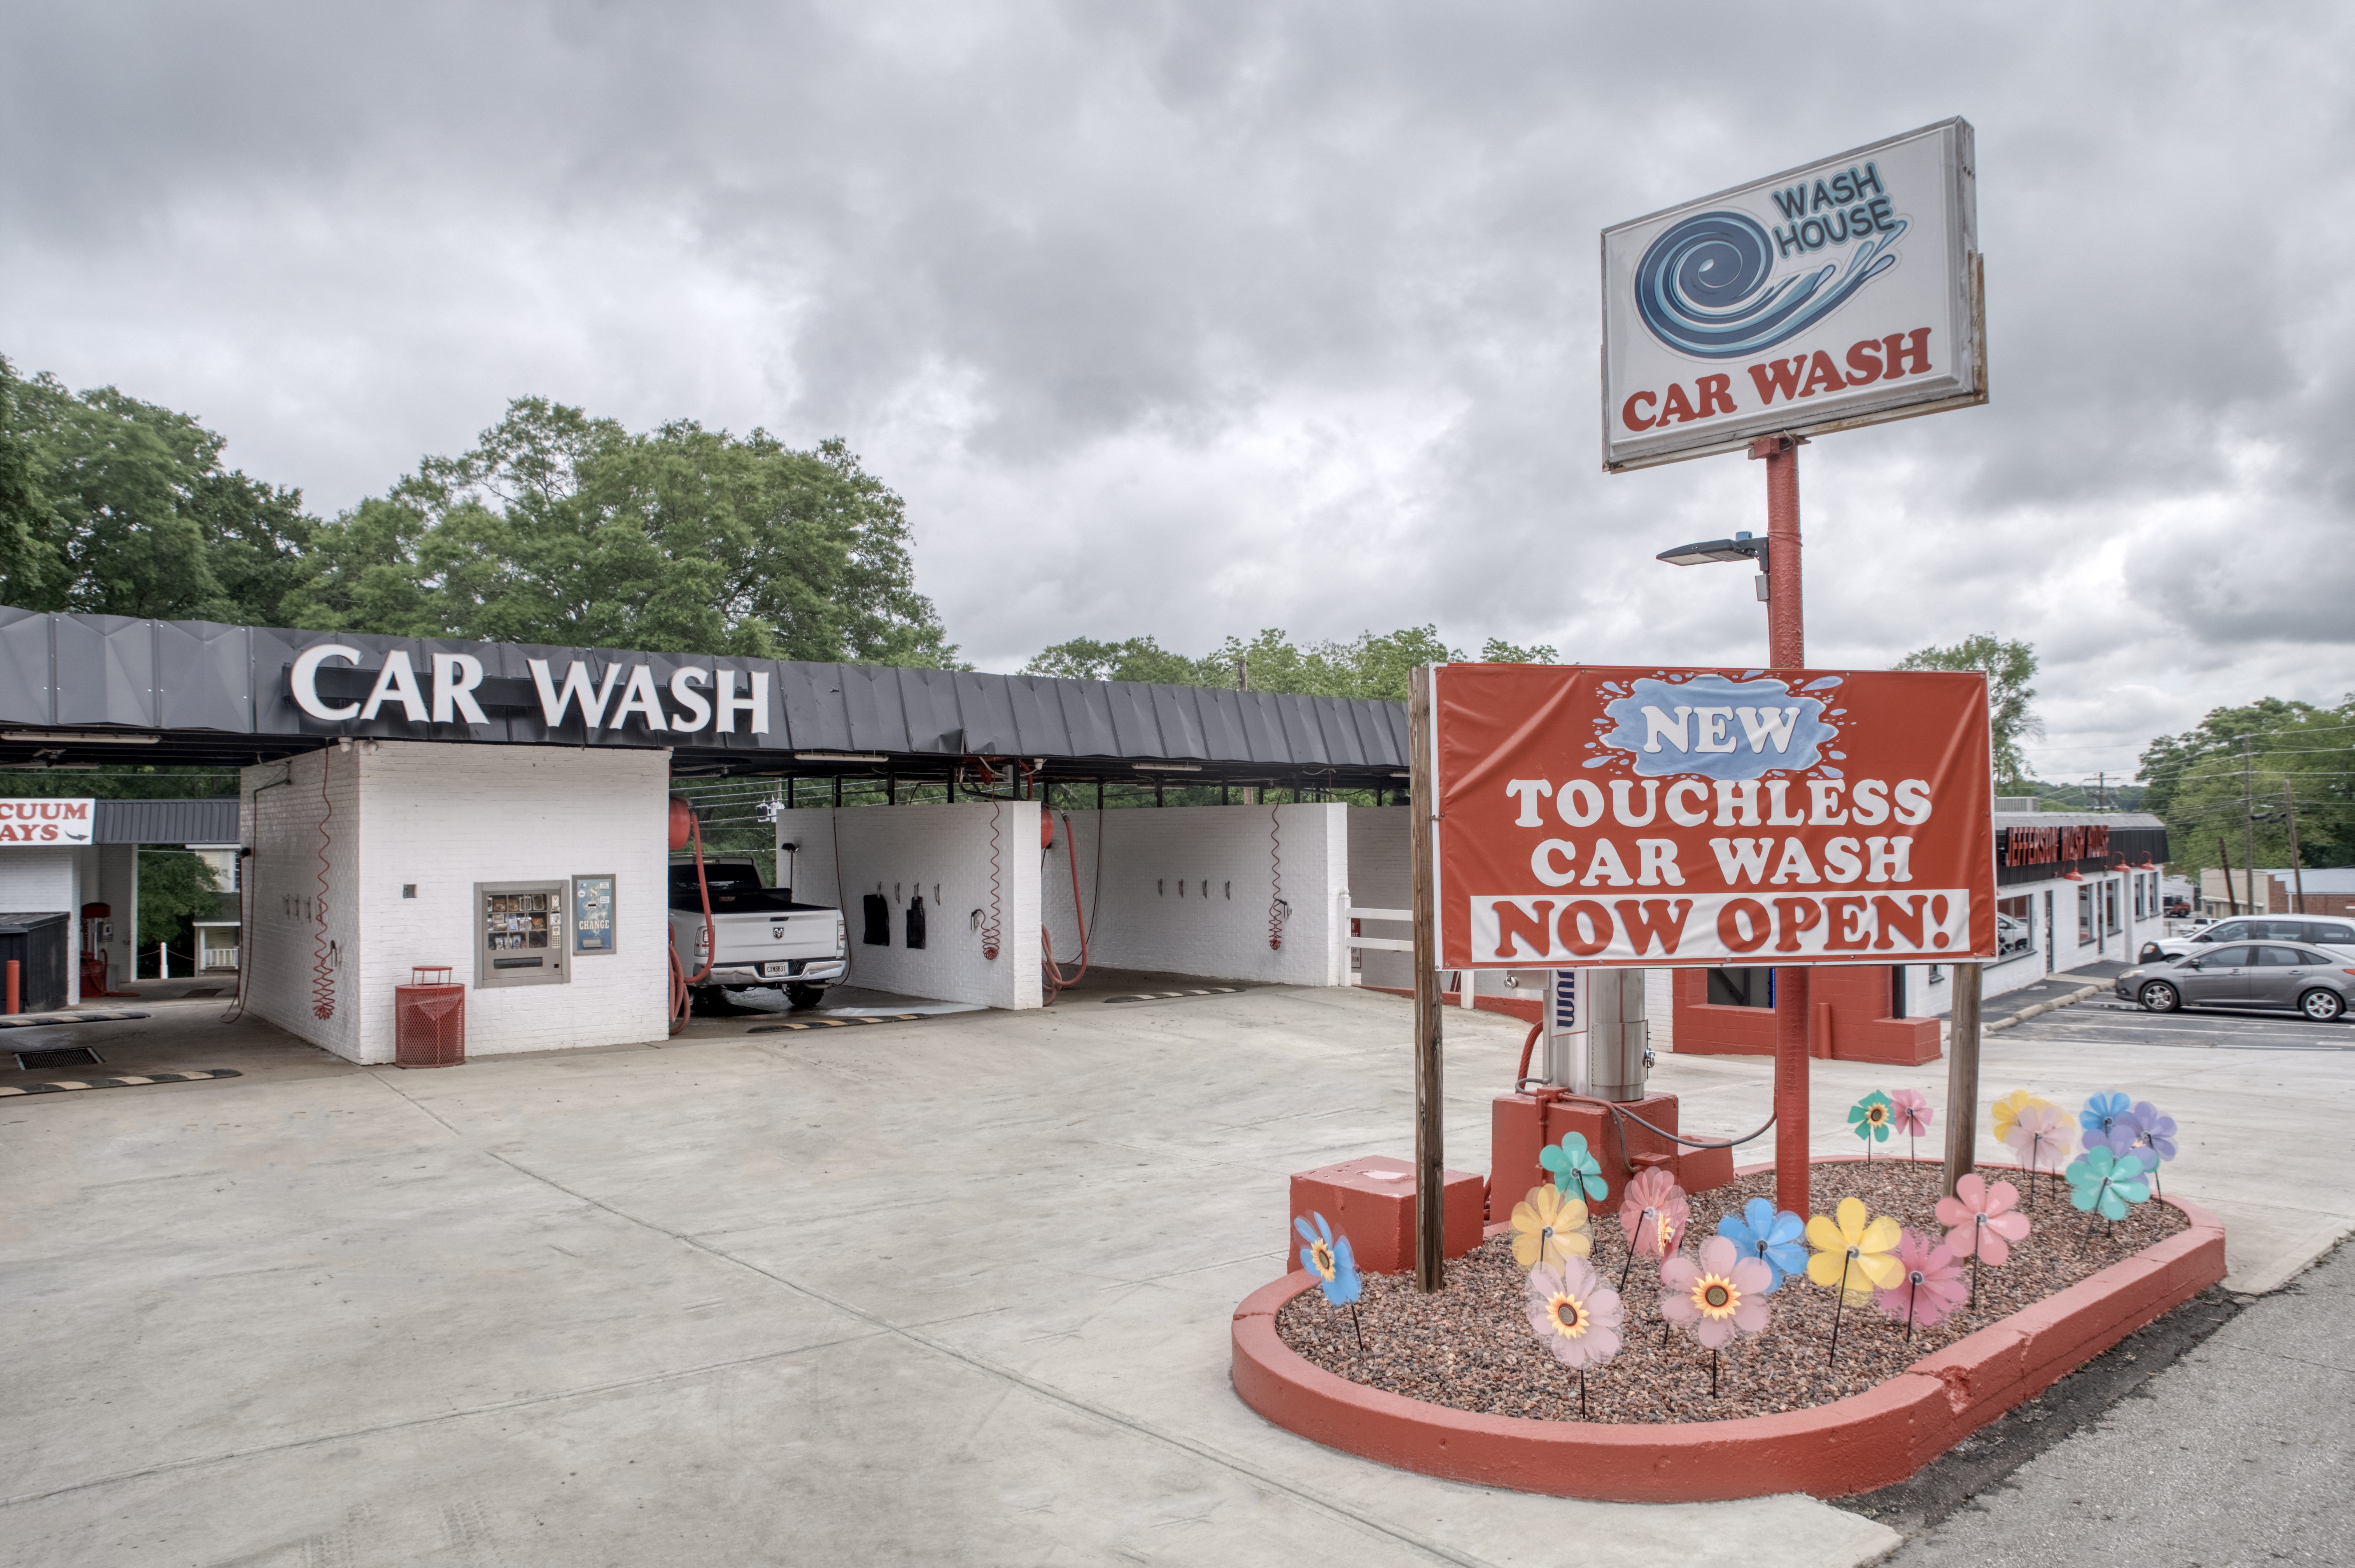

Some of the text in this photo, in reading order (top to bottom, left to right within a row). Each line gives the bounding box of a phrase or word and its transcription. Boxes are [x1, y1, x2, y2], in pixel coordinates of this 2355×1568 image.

[1774, 165, 1881, 219] WASH
[1774, 198, 1896, 256] HOUSE
[1622, 327, 1932, 432] CAR WASH
[291, 644, 769, 734] CAR WASH
[1641, 705, 1801, 753] NEW
[0, 803, 88, 820] CUUM
[1506, 778, 1932, 828] TOUCHLESS
[1531, 836, 1913, 887] CAR WASH
[579, 919, 609, 930] CHANGE
[1492, 894, 1949, 957] NOW OPEN!
